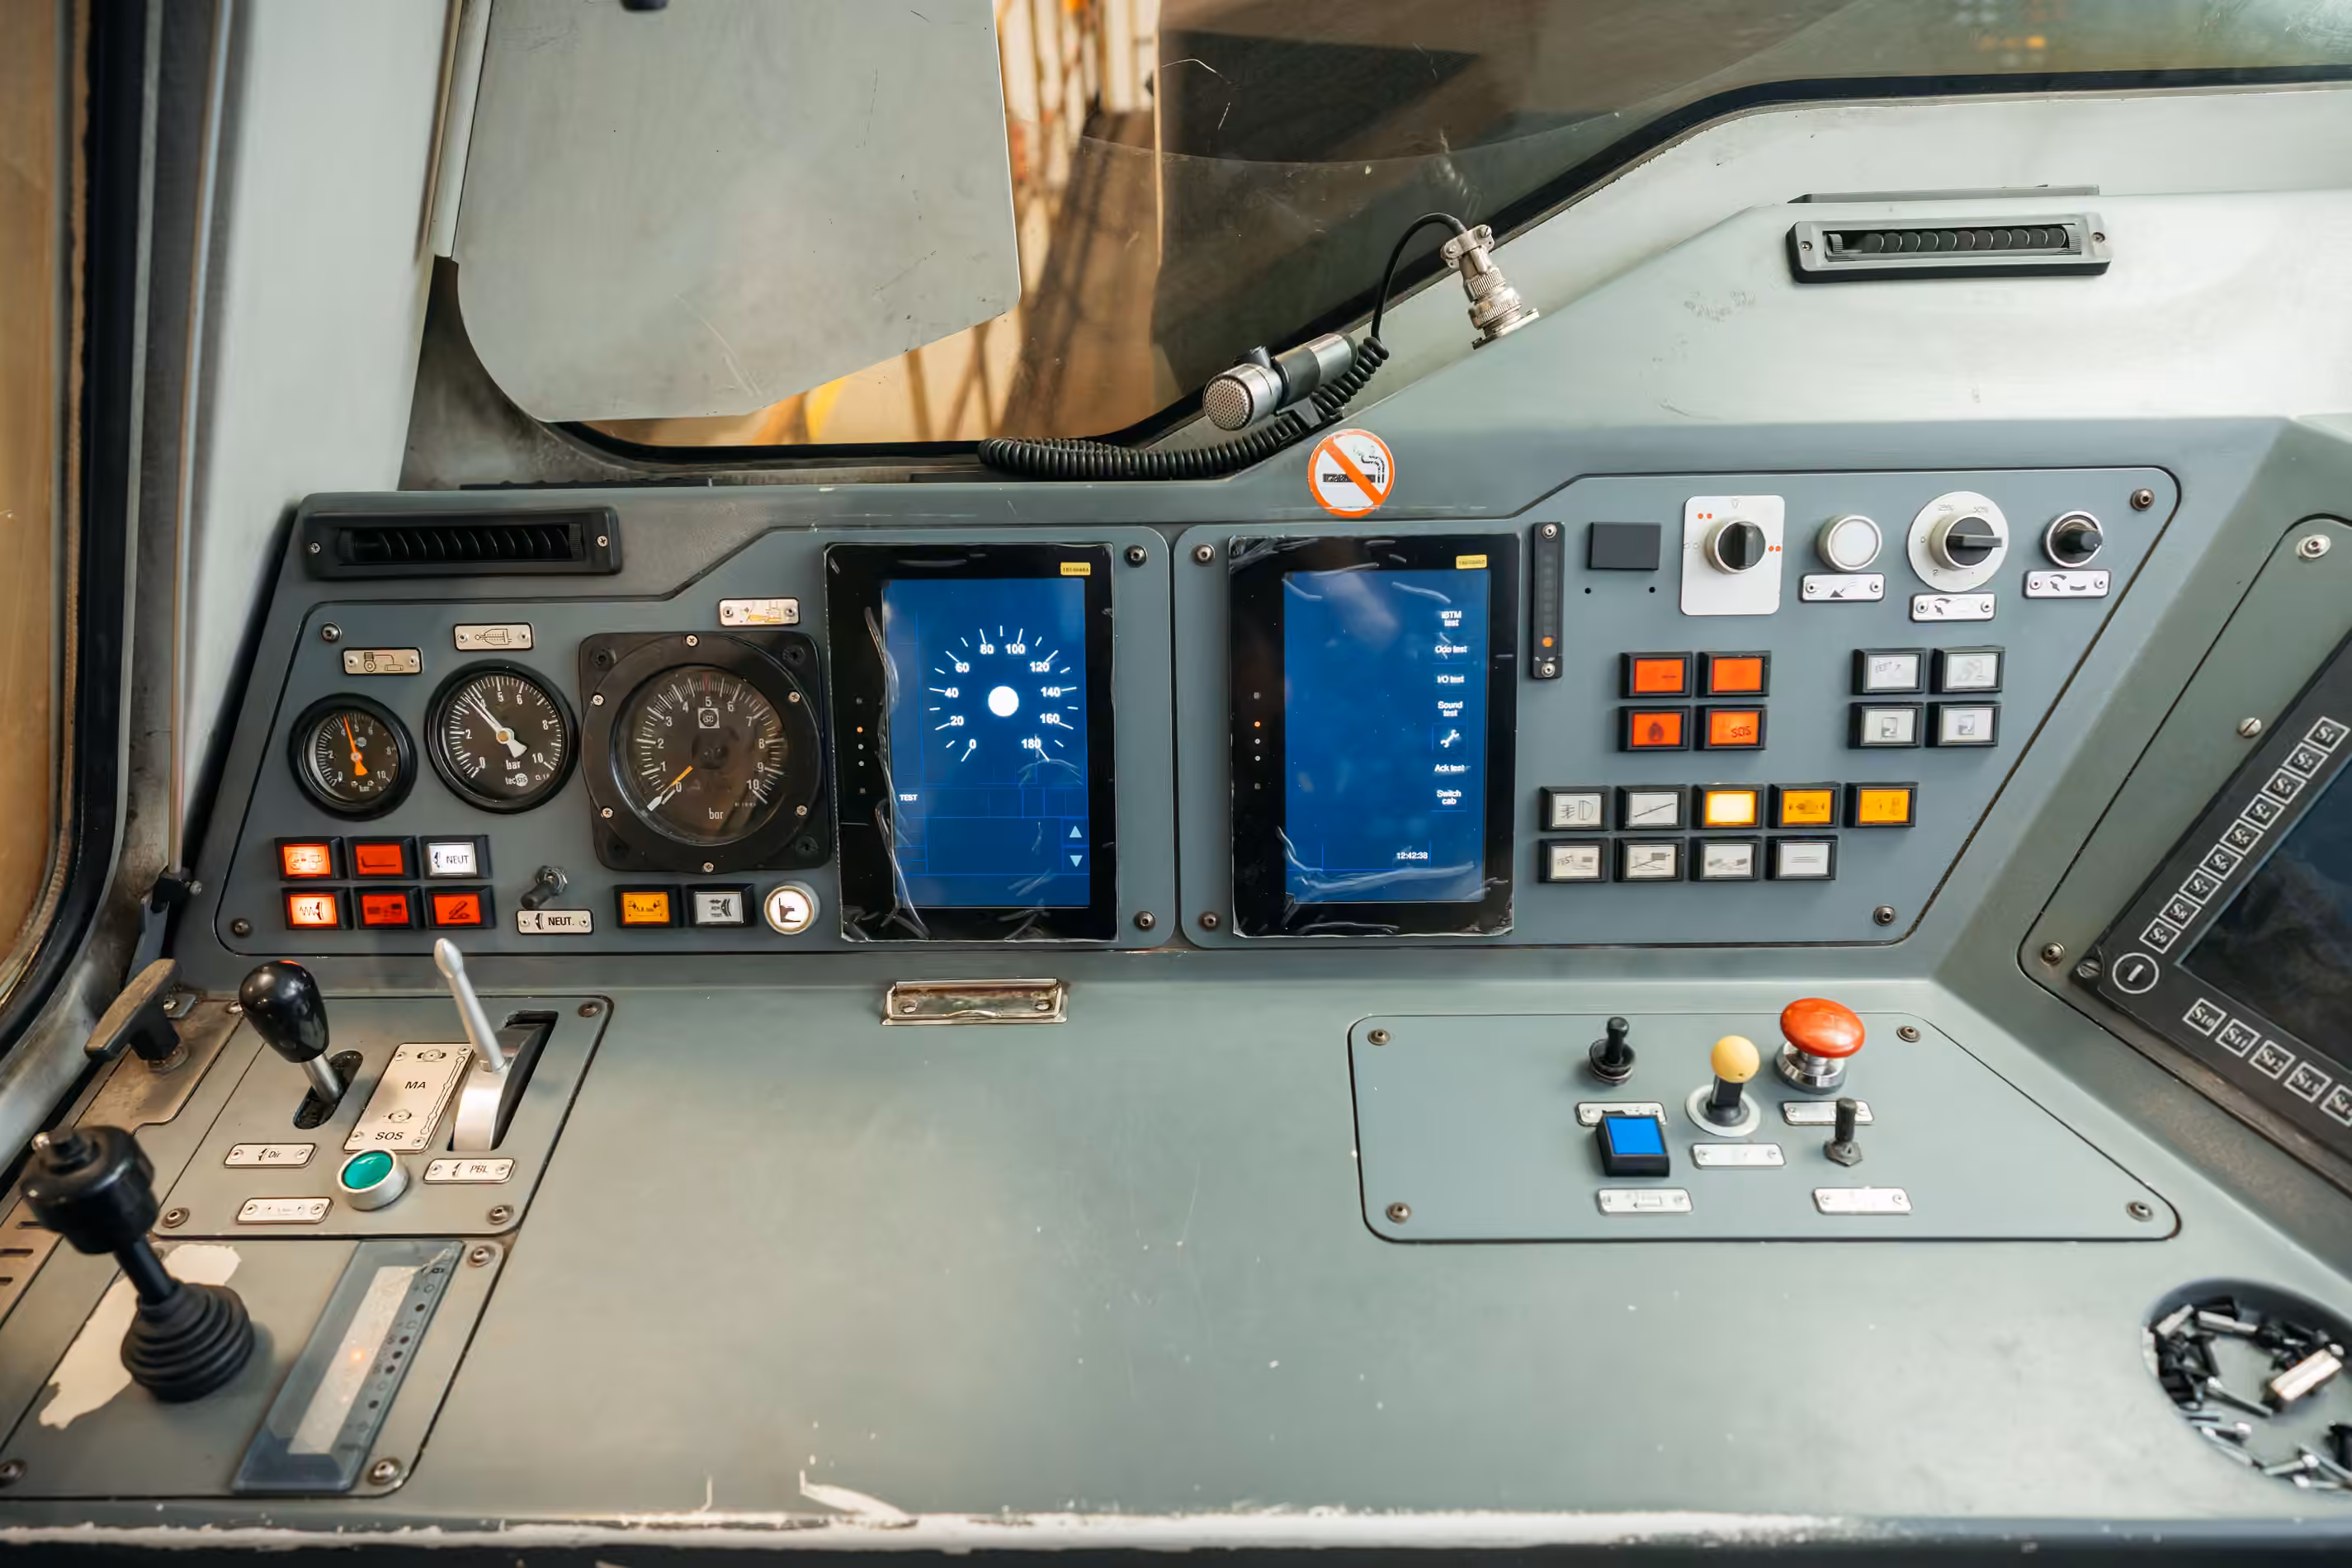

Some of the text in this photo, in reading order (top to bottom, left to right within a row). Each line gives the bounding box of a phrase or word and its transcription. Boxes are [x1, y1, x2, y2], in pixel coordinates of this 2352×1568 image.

[980, 644, 994, 654] 80
[1005, 644, 1025, 654] 100
[1452, 645, 1467, 654] test
[955, 663, 970, 673] 60
[1030, 662, 1050, 672] 120
[1450, 675, 1465, 683] test
[498, 692, 504, 702] 5
[945, 687, 959, 697] 40
[1041, 687, 1060, 697] 140
[517, 695, 523, 705] 6
[706, 697, 712, 707] 5
[1438, 701, 1463, 709] Sound
[682, 702, 688, 713] 4
[727, 701, 734, 712] 6
[666, 716, 673, 726] 3
[746, 716, 753, 727] 7
[950, 716, 964, 725] 20
[1040, 714, 1060, 723] 160
[542, 720, 549, 730] 8
[465, 730, 472, 739] 2
[1731, 725, 1752, 739] SOS
[657, 739, 664, 749] 2
[758, 739, 765, 749] 8
[969, 739, 976, 749] 0
[1021, 739, 1041, 749] 180
[328, 750, 334, 758] 2
[532, 753, 544, 764] 10
[479, 757, 486, 769] 0
[506, 759, 521, 770] bar
[661, 761, 666, 772] 1
[758, 763, 764, 772] 9
[1434, 764, 1465, 772] Ack test
[376, 770, 386, 779] 10
[675, 782, 682, 793] 0
[746, 779, 760, 791] 10
[1437, 789, 1462, 797] Switch
[709, 807, 724, 819] bar
[446, 854, 469, 864] NEUT
[2190, 877, 2208, 895] S7
[2170, 903, 2188, 920] S8
[548, 916, 575, 927] NEUT.
[2151, 927, 2169, 944] S9
[2192, 1005, 2215, 1027] S10
[404, 1081, 427, 1089] MA
[375, 1131, 404, 1141] SOS
[268, 1150, 281, 1159] Dir
